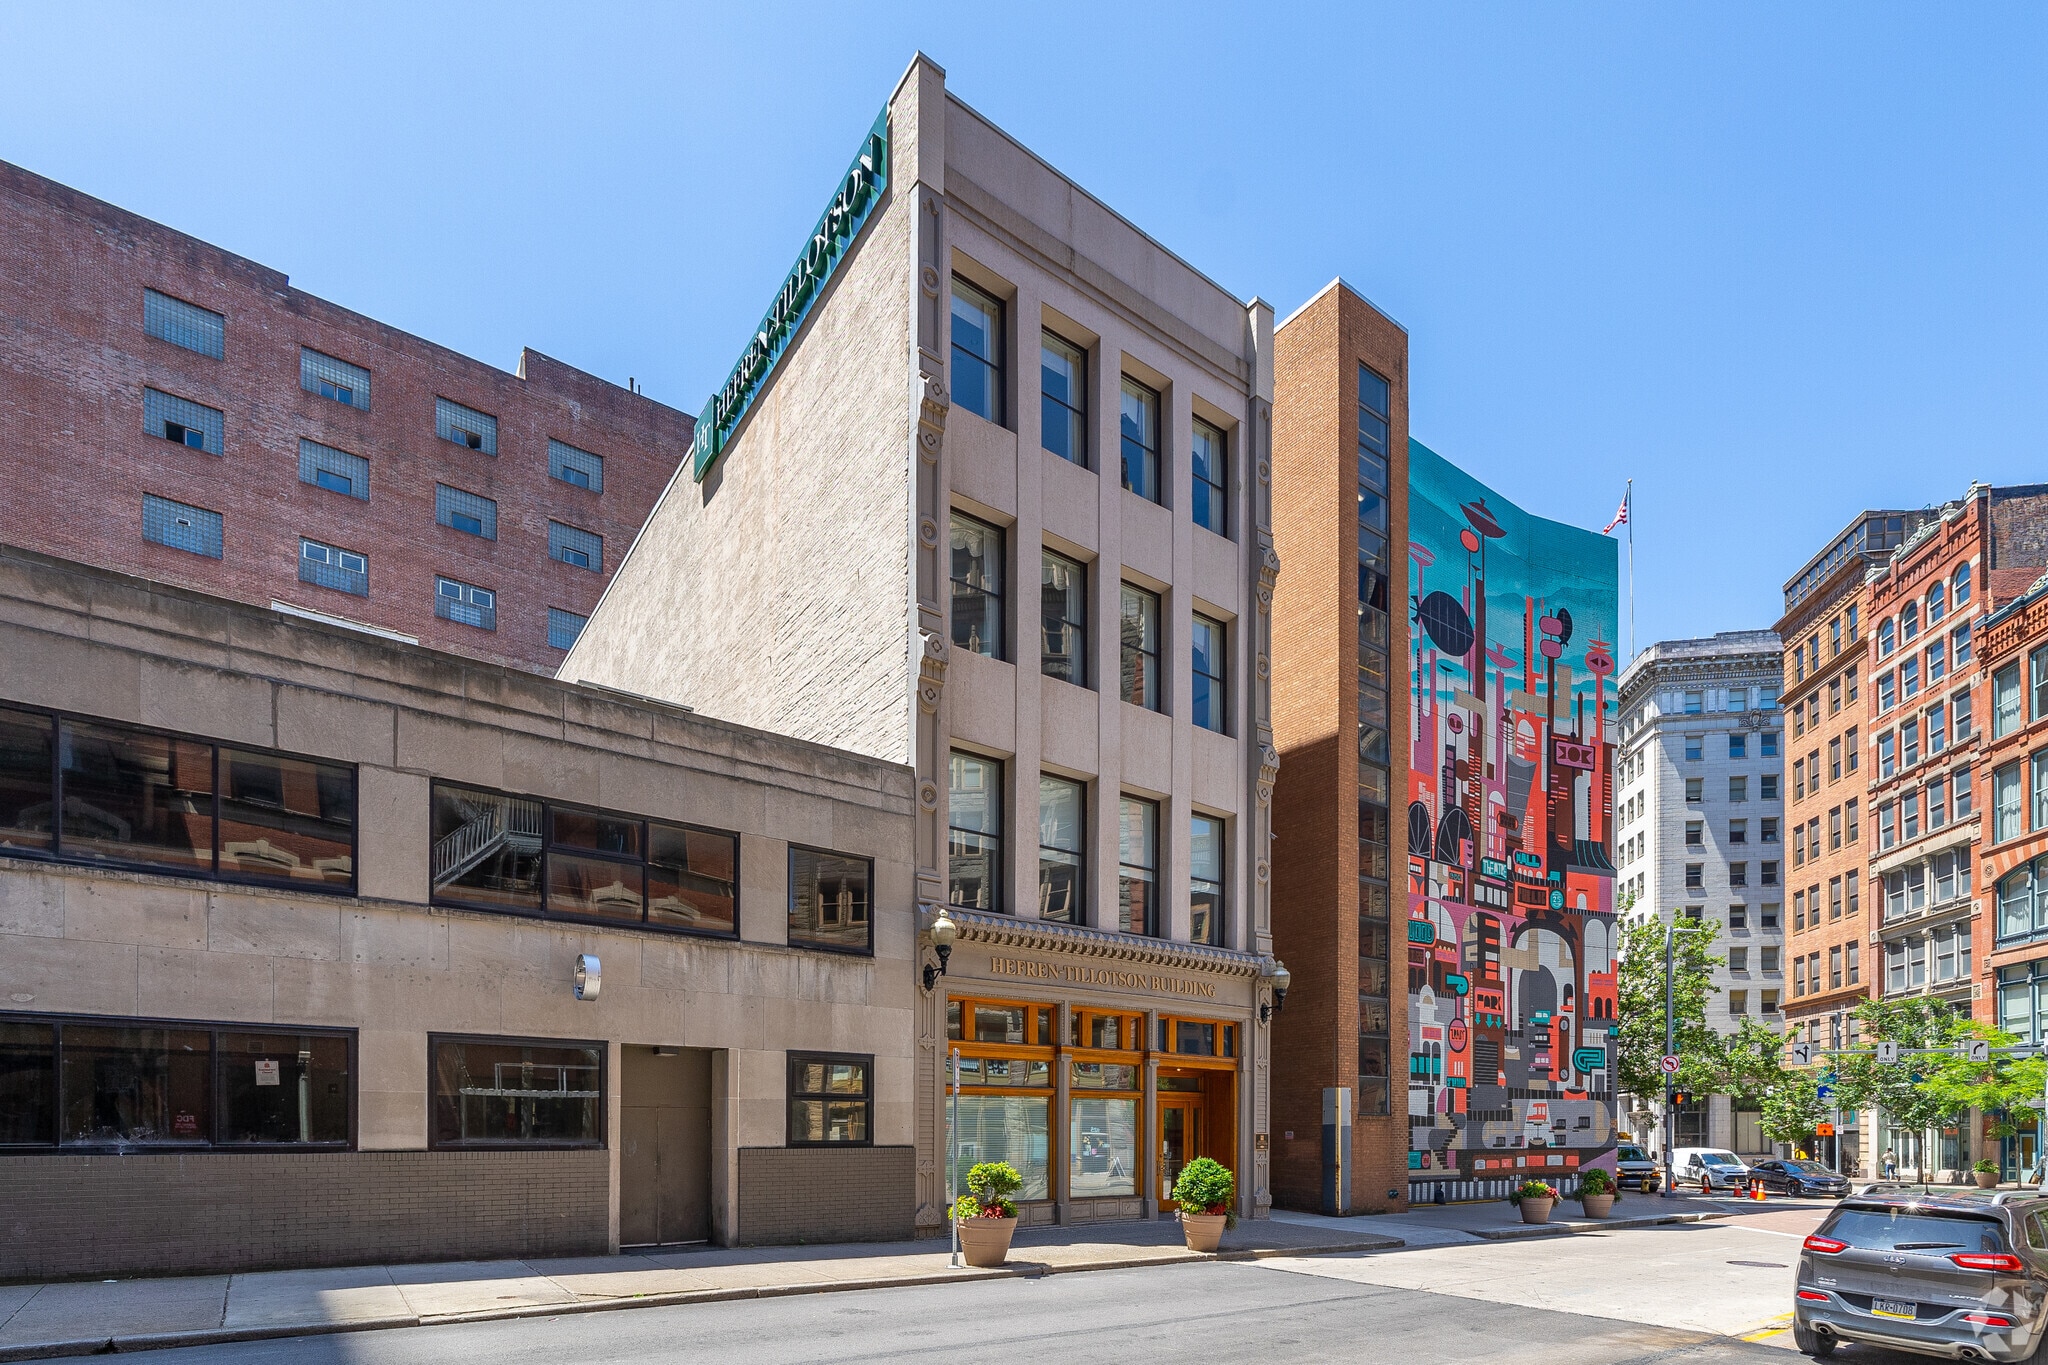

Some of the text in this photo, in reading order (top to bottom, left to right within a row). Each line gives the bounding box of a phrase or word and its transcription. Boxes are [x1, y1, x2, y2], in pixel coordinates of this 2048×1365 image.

[991, 957, 1216, 998] HEFREN-TILLOTSON BUILDING
[1883, 1255, 1906, 1266] Jeep
